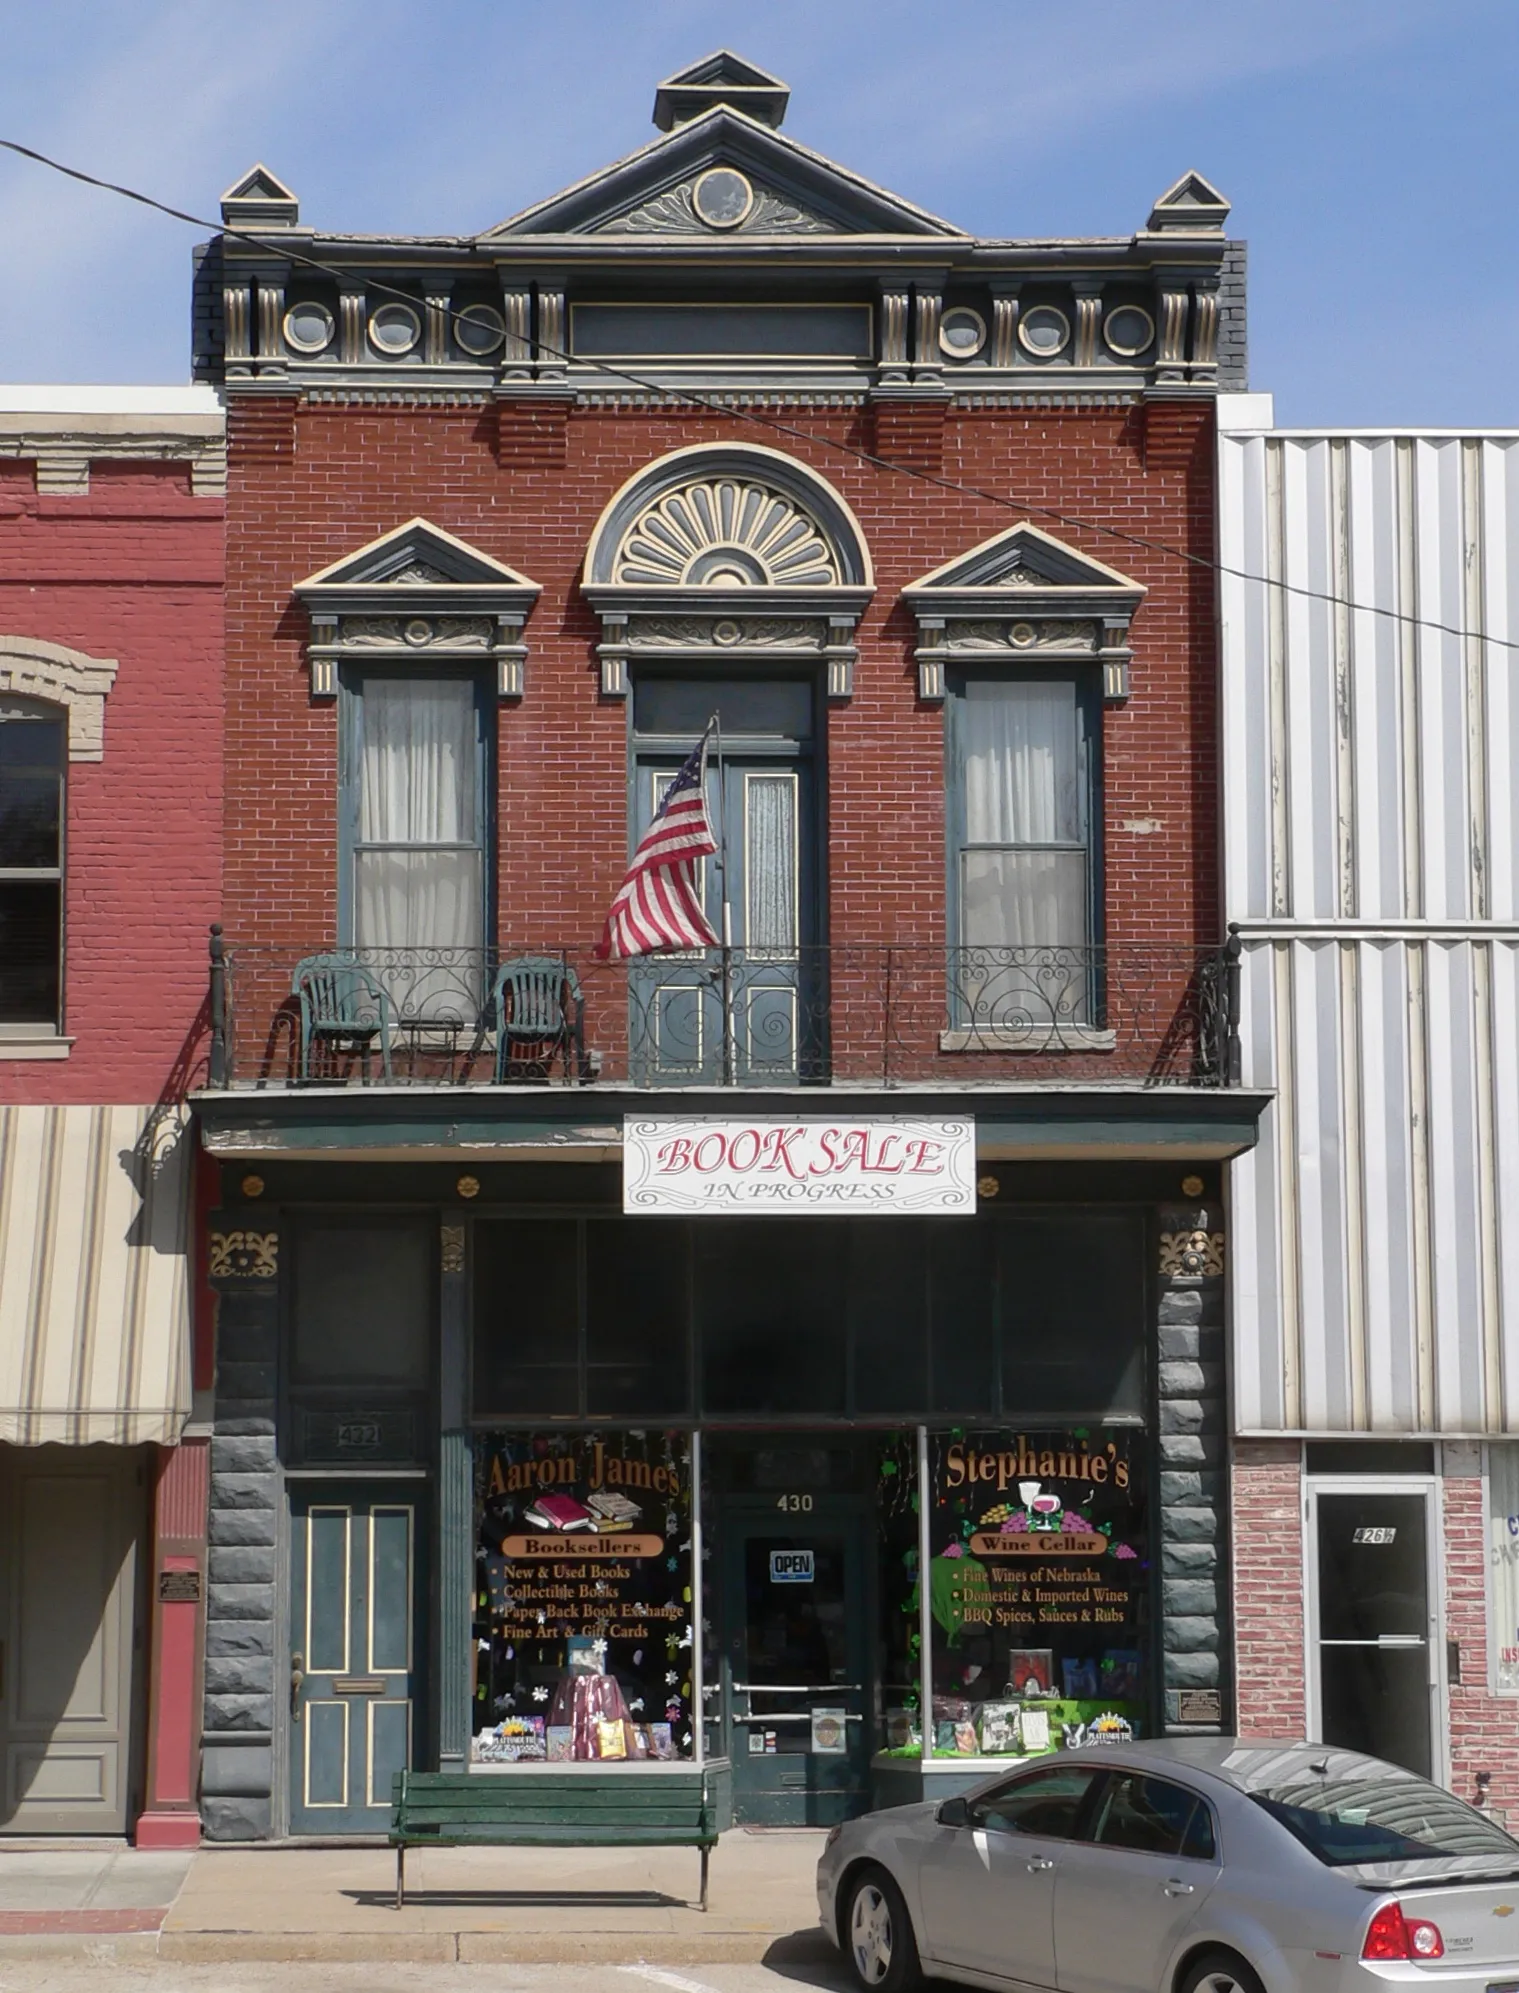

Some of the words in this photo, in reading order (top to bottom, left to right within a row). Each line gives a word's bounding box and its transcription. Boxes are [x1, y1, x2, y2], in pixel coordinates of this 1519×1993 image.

[657, 1127, 807, 1182] BOOK
[809, 1127, 946, 1176] SALE
[703, 1183, 744, 1200] IN
[747, 1183, 897, 1203] PROGRESS
[340, 1426, 377, 1444] 432
[486, 1454, 578, 1499] Aaron
[589, 1442, 681, 1497] James
[946, 1434, 1130, 1492] Stephanie's
[776, 1494, 814, 1512] 430
[524, 1538, 642, 1555] Booksellers
[981, 1536, 1031, 1551] Wine
[1038, 1536, 1097, 1551] Cellar
[503, 1565, 534, 1579] New
[537, 1566, 549, 1579] &
[553, 1565, 586, 1579] Used
[591, 1564, 631, 1580] Books
[774, 1555, 811, 1573] OPEN
[963, 1567, 988, 1582] Fine
[991, 1568, 1027, 1583] Wines
[1029, 1567, 1045, 1582] of
[1046, 1568, 1101, 1583] Nebraska
[503, 1583, 575, 1599] Collectible
[579, 1583, 620, 1599] Books
[963, 1588, 1019, 1602] Domestic
[1021, 1589, 1032, 1602] &
[1035, 1587, 1090, 1606] Imported
[1093, 1588, 1129, 1602] Wines
[546, 1603, 580, 1618] Back
[583, 1603, 618, 1618] Book
[963, 1607, 993, 1626] BBQ
[995, 1608, 1036, 1627] Spices,
[1039, 1607, 1078, 1623] Sauces
[1080, 1609, 1091, 1623] &
[1094, 1607, 1125, 1623] Rubs
[503, 1623, 533, 1639] Fine
[536, 1624, 559, 1639] Art
[563, 1625, 576, 1639] &
[581, 1624, 606, 1639] Gift
[609, 1623, 649, 1639] Cards
